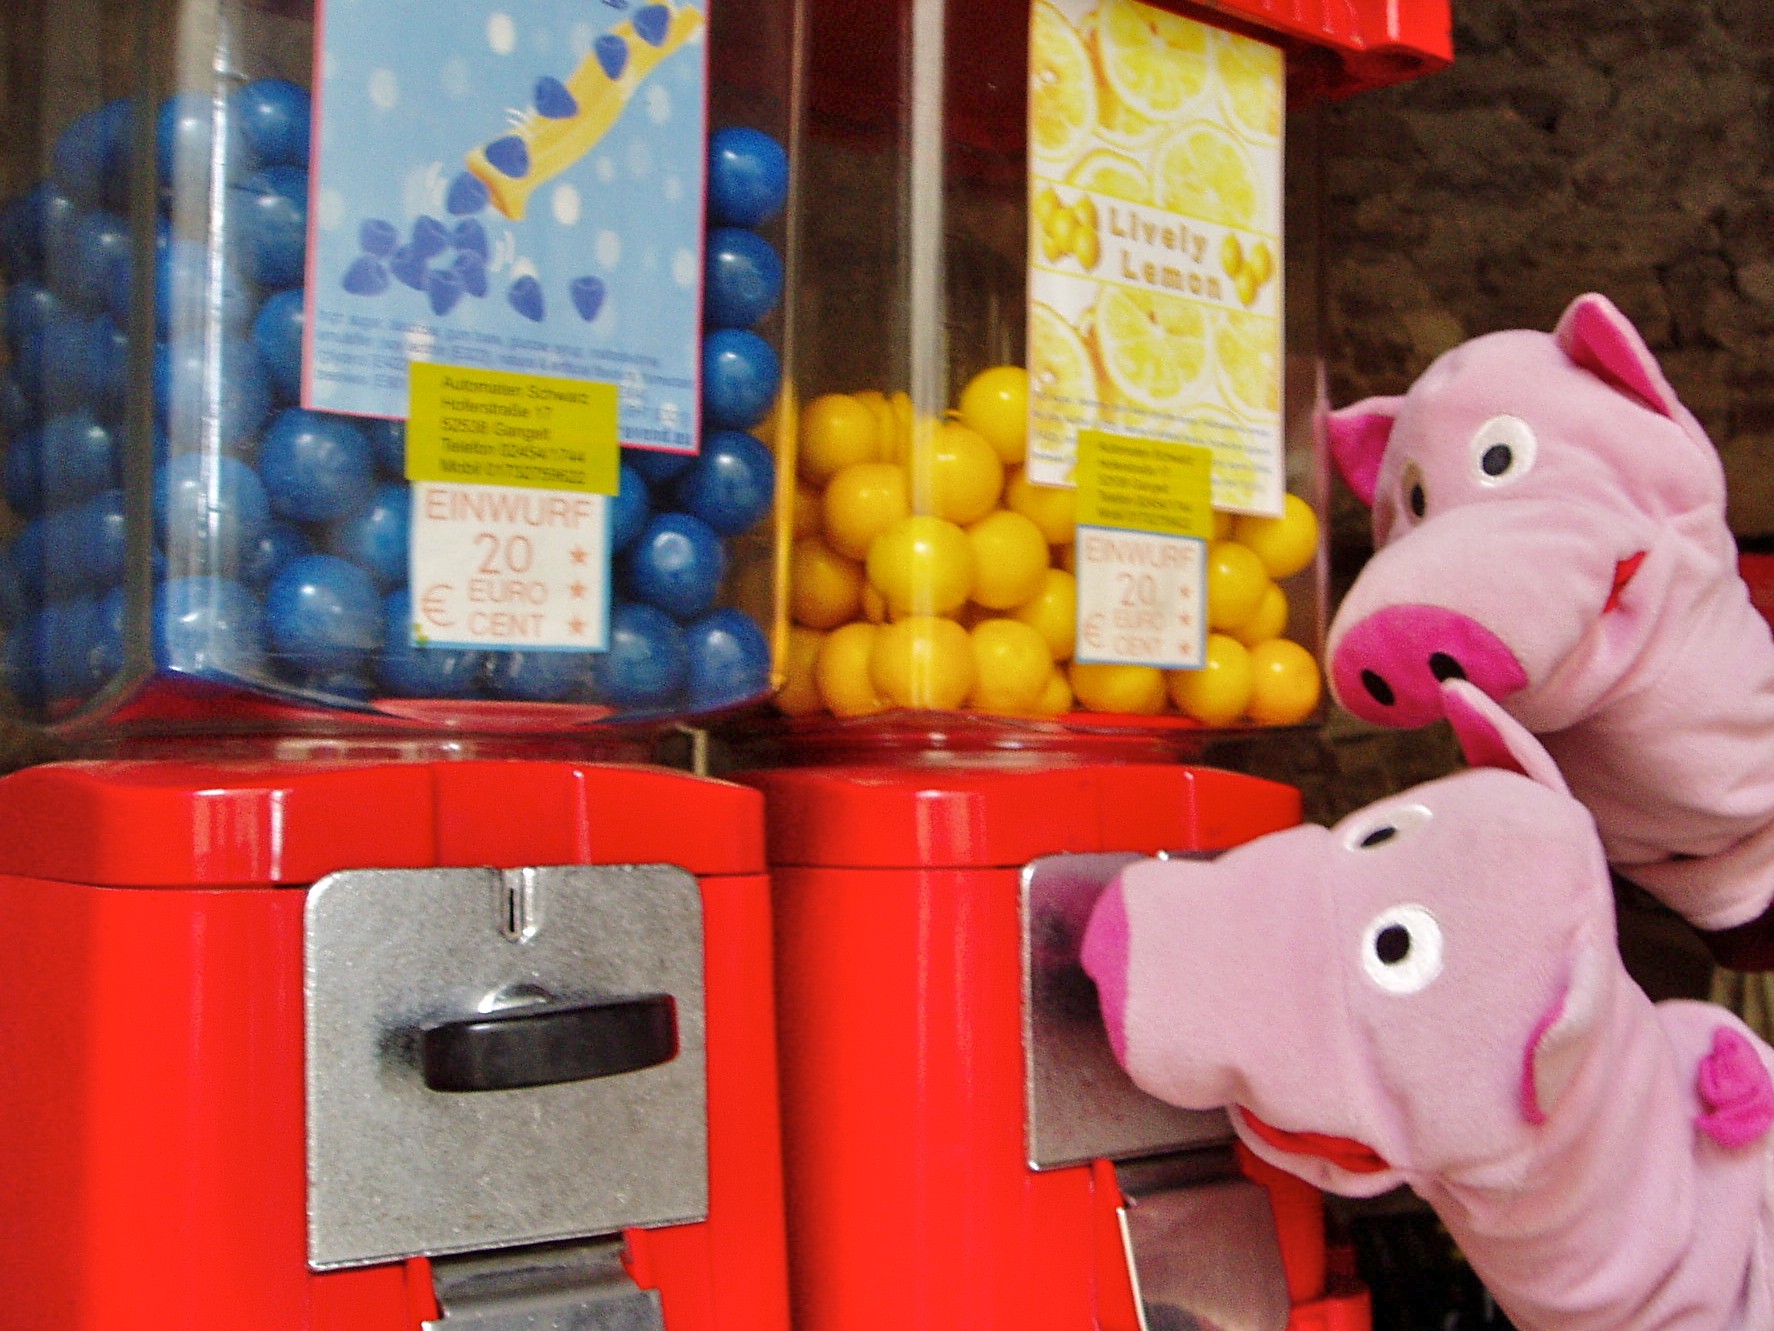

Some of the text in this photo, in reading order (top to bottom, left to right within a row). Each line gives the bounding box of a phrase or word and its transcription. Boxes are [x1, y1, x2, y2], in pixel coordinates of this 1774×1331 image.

[1109, 206, 1207, 264] Lively
[1120, 249, 1222, 301] Lemon
[425, 487, 592, 528] EINWURF
[473, 531, 534, 576] 20
[1085, 536, 1194, 569] EINWURF
[467, 577, 549, 606] EURO
[1117, 570, 1158, 607] 20
[467, 610, 545, 638] CENT
